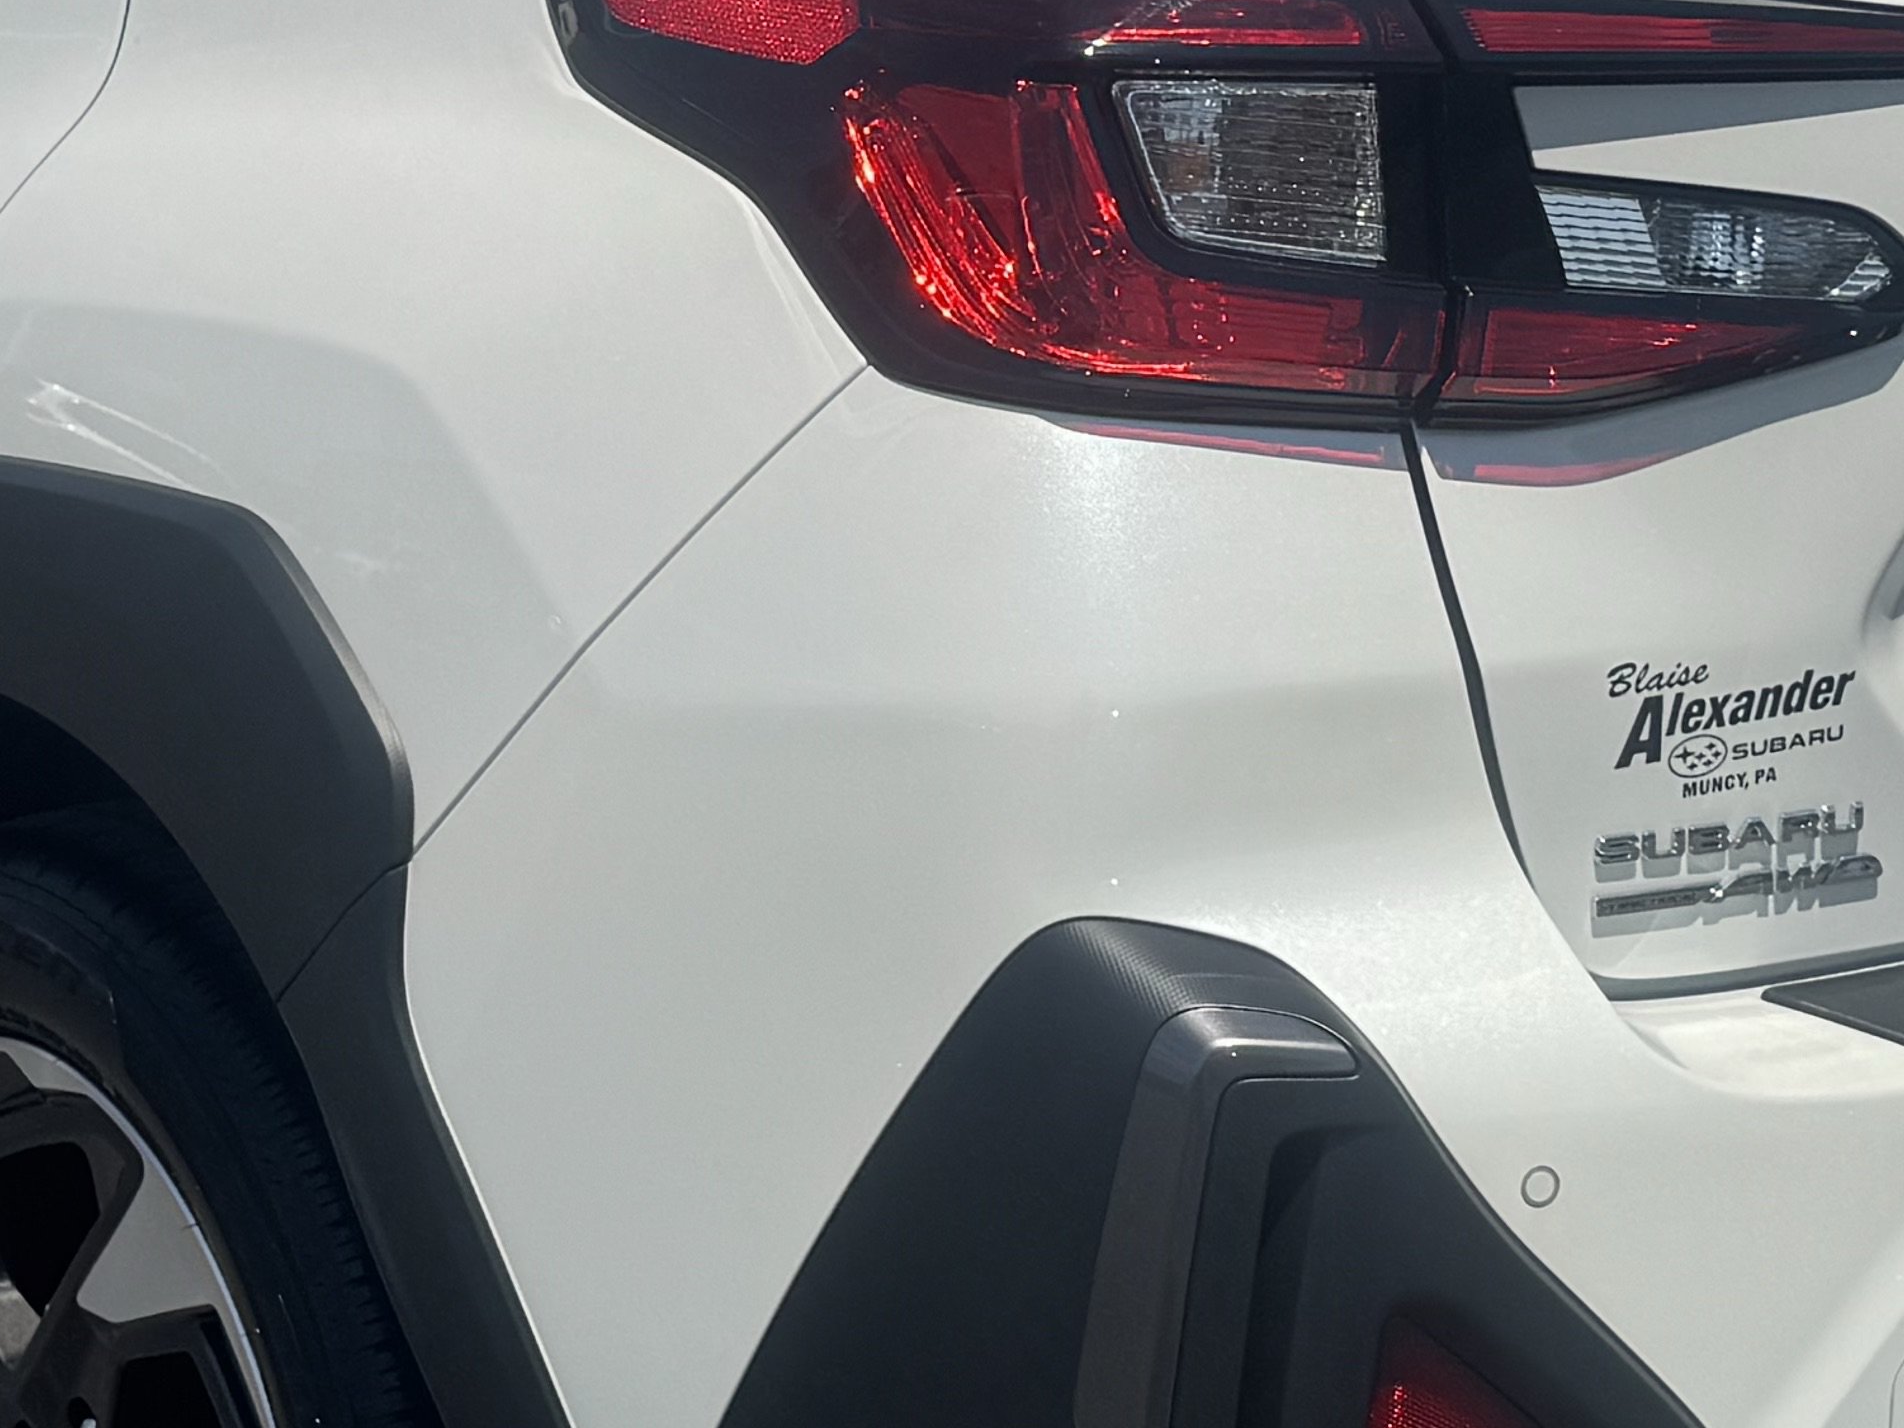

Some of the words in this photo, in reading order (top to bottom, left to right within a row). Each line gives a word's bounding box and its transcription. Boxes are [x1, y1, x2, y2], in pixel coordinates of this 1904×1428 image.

[1607, 661, 1709, 698] Blaise
[1613, 669, 1856, 770] Alexander
[1731, 724, 1844, 760] SUBARU
[1682, 771, 1749, 799] MUNCY,
[1755, 767, 1778, 785] PA
[1594, 801, 1864, 864] SUBARU
